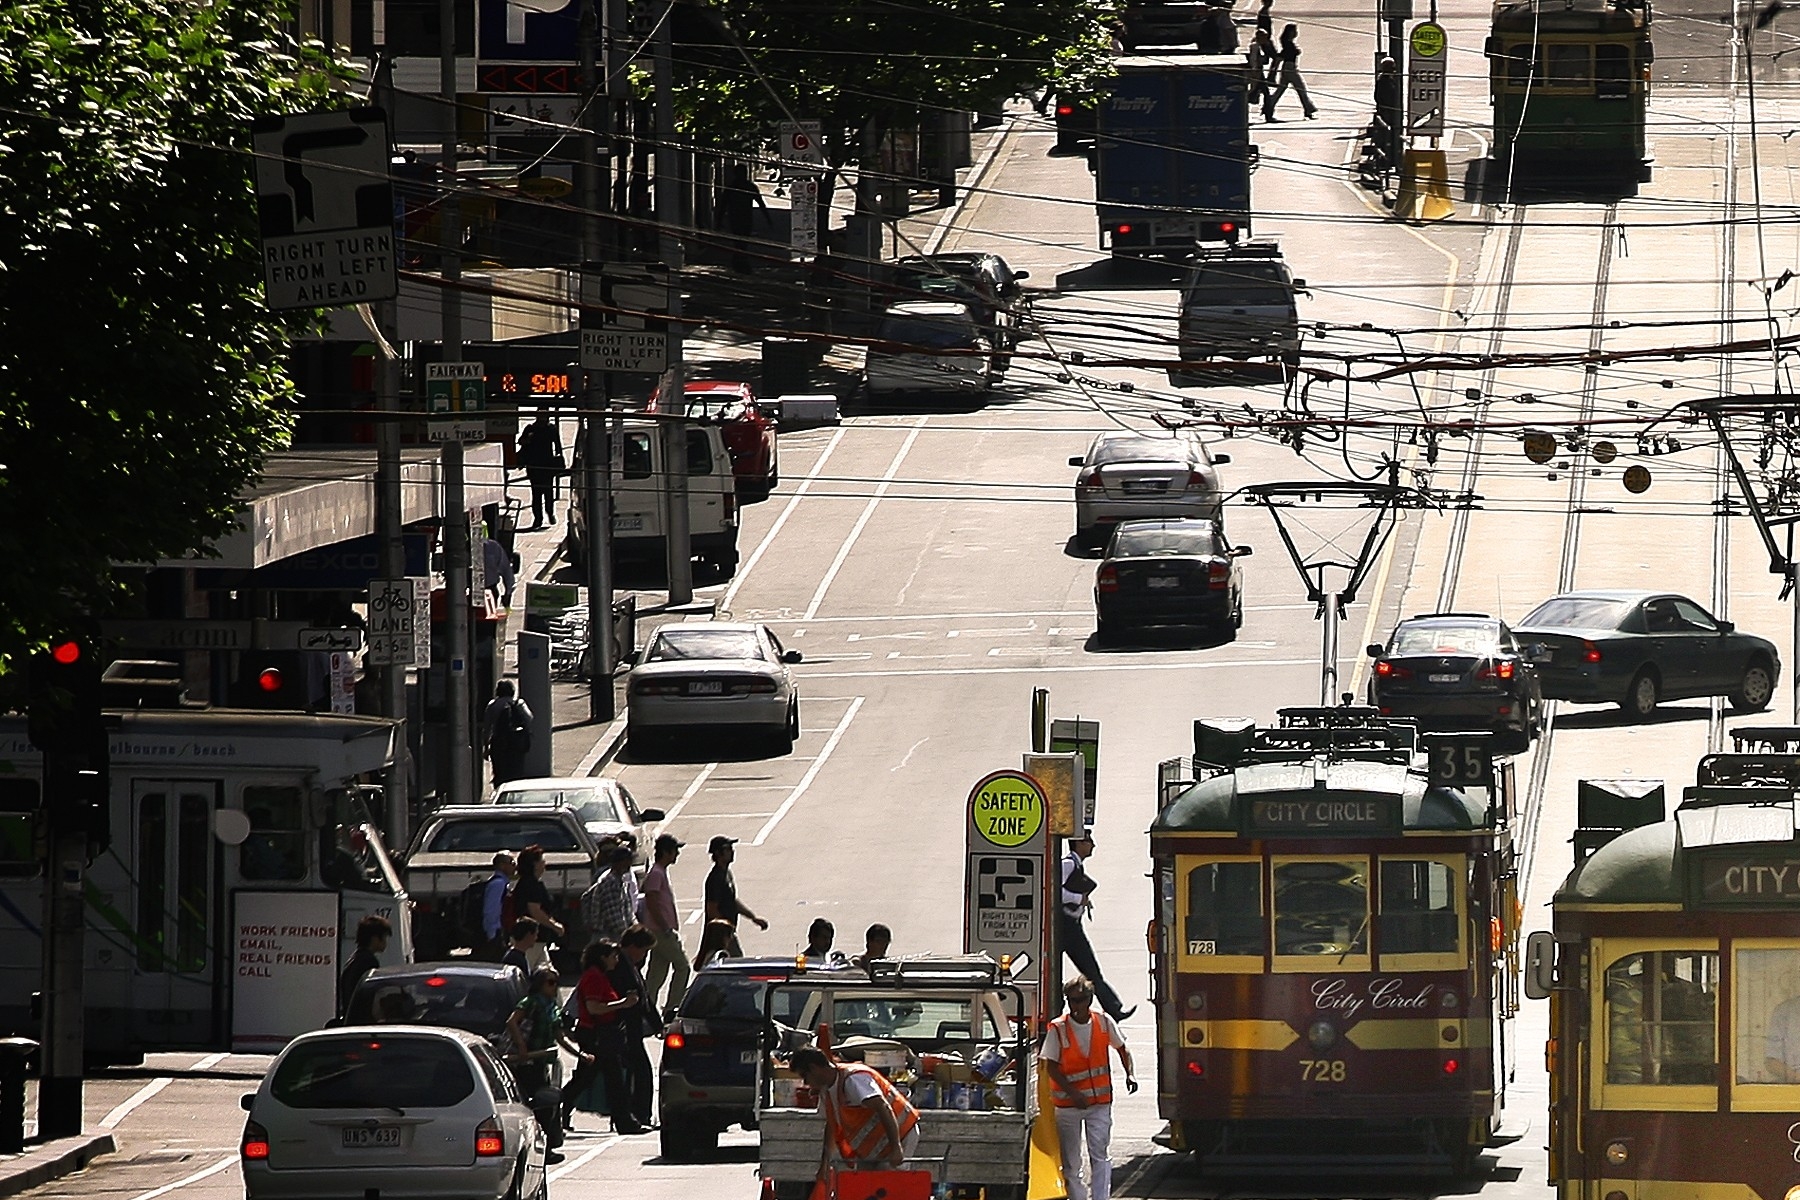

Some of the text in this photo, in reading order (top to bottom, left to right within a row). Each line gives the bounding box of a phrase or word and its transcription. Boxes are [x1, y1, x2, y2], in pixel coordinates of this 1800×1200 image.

[1412, 89, 1440, 101] LEFT
[267, 236, 389, 262] RIGHT TURN
[272, 257, 387, 283] FROM LEFT
[298, 280, 366, 301] AHEAD
[583, 333, 665, 347] RIGHT TURN
[585, 346, 662, 359] FROM LEFT
[605, 359, 641, 369] ONLY
[429, 365, 480, 378] FAIRWAY
[501, 372, 518, 393] &
[431, 430, 484, 441] ALL TIMES
[372, 617, 410, 633] LANE
[110, 740, 176, 755] elbourne
[1439, 746, 1482, 779] 35
[980, 792, 1035, 811] SAFETY
[1267, 801, 1376, 821] CITY CIRCLE
[989, 817, 1027, 836] ZONE
[1725, 865, 1788, 893] CITY
[982, 911, 1029, 921] RIGHT TURN
[240, 926, 335, 937] WORK FRIENDS
[983, 921, 1028, 929] FROM LEFT
[240, 939, 282, 950] EMAIL,
[1190, 942, 1215, 954] 728
[239, 953, 331, 965] REAL FRIENDS
[239, 966, 271, 977] CALL
[1310, 978, 1435, 1019] City Circle
[1299, 1060, 1347, 1082] 728
[376, 1130, 398, 1142] 639
